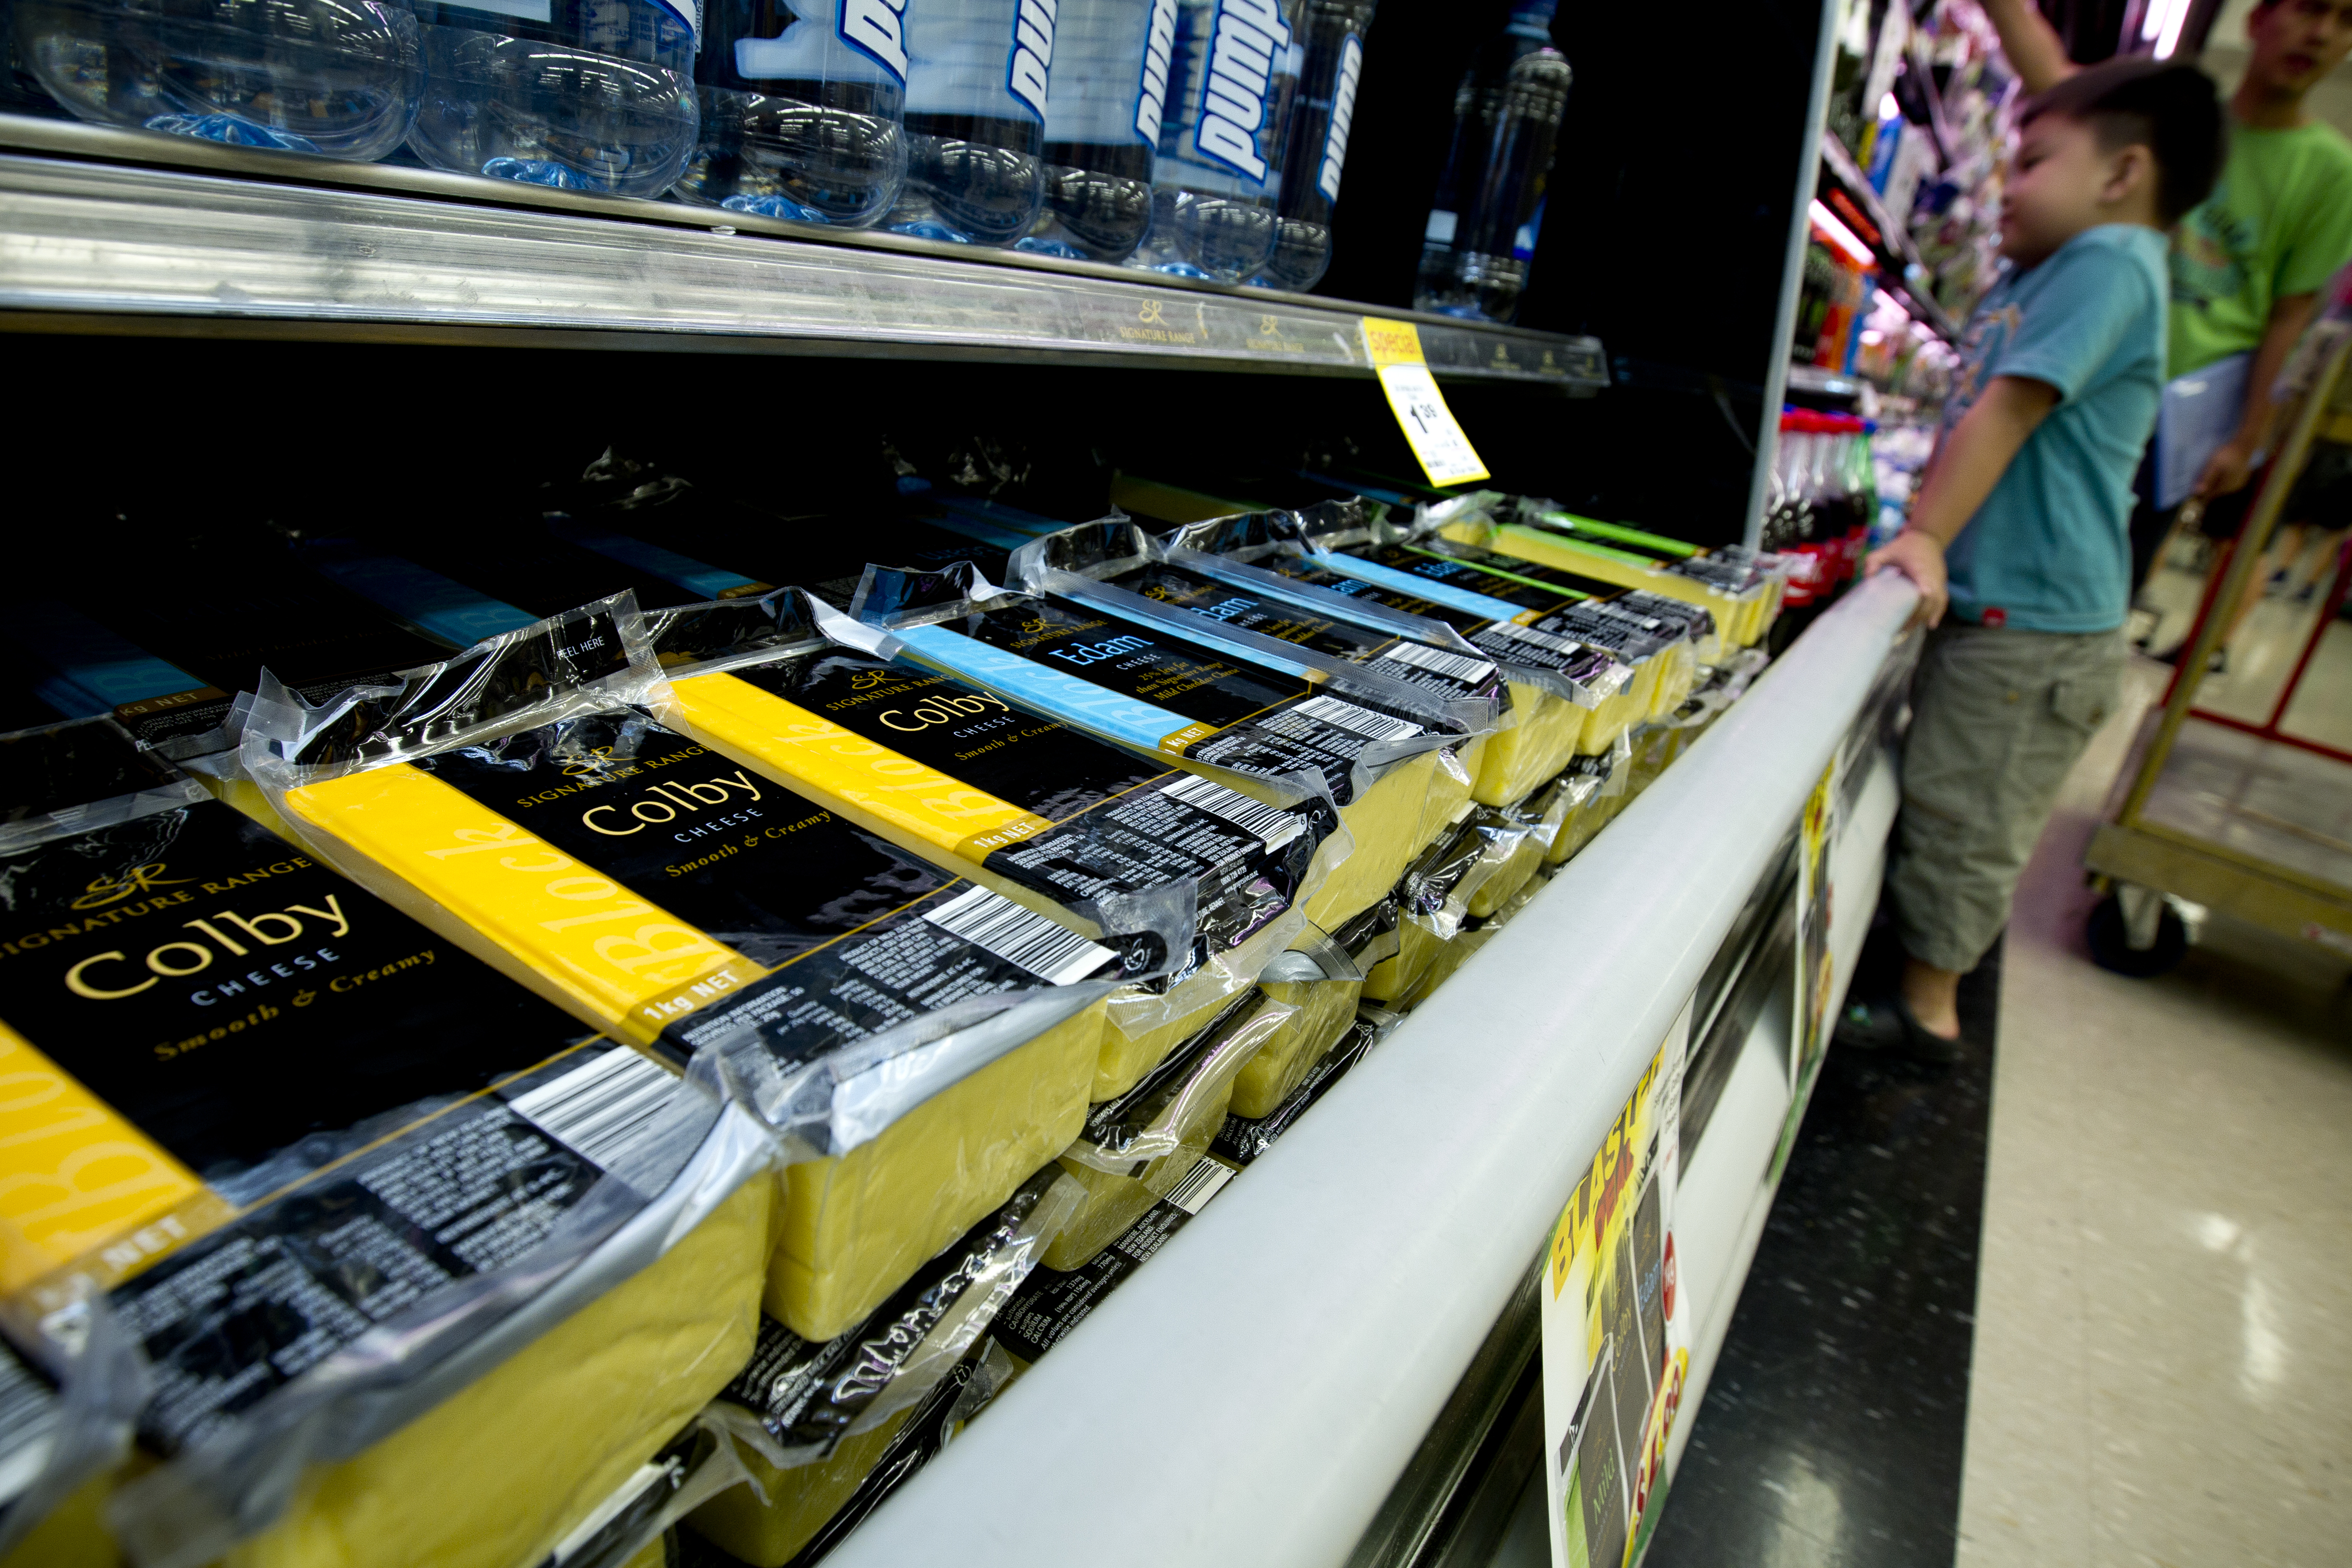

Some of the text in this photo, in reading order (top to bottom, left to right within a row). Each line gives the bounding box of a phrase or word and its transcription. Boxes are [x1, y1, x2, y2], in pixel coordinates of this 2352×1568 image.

[1170, 331, 1195, 344] RANGE
[1190, 597, 1260, 622] dam
[1238, 613, 1268, 627] HEESE
[581, 636, 605, 655] HERE
[1010, 619, 1108, 649] SIGNATURE RANGE
[1048, 635, 1154, 666] Edam
[1116, 653, 1162, 670] CHEESE
[1136, 661, 1224, 694] than Signature Range
[1173, 661, 1189, 673] for
[826, 673, 955, 710] SIGNATURE RANG
[1153, 668, 1240, 701] Mild Cheddar Cheese
[155, 693, 198, 706] NET
[879, 691, 1010, 732] Colby
[137, 702, 233, 734] UTRITION INFORMATION
[141, 719, 174, 737] ERVINGS
[953, 716, 1016, 738] CHEESE
[146, 723, 174, 740] ERVING
[955, 720, 1068, 761] Smooth & Creamy
[1180, 727, 1205, 739] NET
[517, 744, 714, 809] SIGNATURE RANGE
[772, 721, 1004, 821] Block
[582, 771, 762, 836] Colby
[1105, 807, 1127, 816] PRODUCT
[1112, 809, 1137, 820] PRODUCTS
[1129, 809, 1150, 818] QUALITY
[1155, 811, 1174, 819] RETURN
[1176, 808, 1194, 816] REFUND
[674, 808, 763, 843] CHEESE
[1002, 821, 1035, 839] NET
[1105, 829, 1125, 840] Quantity
[1163, 827, 1191, 841] REFRIGERATE
[1174, 830, 1209, 846] MANUFACTURED
[665, 810, 832, 878] Smooth & Creamy
[1035, 834, 1073, 850] INFORMATION
[1050, 838, 1079, 851] PACKAGE:
[1189, 837, 1210, 846] BRANDS
[1222, 851, 1245, 862] PRODUCT
[1237, 841, 1263, 854] ENQUIRIES:
[201, 856, 312, 895] RANGE
[1220, 865, 1247, 886] 0800 728 4739
[425, 822, 705, 976] Block
[64, 894, 350, 1000] Colby
[191, 947, 341, 1007] CHEESE
[154, 948, 437, 1062] Smooth & Creamy
[643, 996, 695, 1020] 1kg
[691, 969, 739, 998] NET
[1217, 1116, 1231, 1139] SODIUM
[1224, 1117, 1239, 1142] CALCIUM
[1237, 1120, 1248, 1137] values
[1594, 1138, 1634, 1252] DEAL
[1117, 1228, 1141, 1251] MANGERE,
[1137, 1209, 1161, 1232] AUCKLAND,
[1124, 1242, 1137, 1255] NEW
[1134, 1225, 1156, 1247] ZEALAND.
[1131, 1212, 1179, 1259] FOR PRODUCT ENQUIRIES:
[1097, 1254, 1115, 1270] 770mg
[1138, 1250, 1151, 1263] NEW
[1639, 1258, 1661, 1314] Edam
[1005, 1296, 1027, 1321] saturated
[1008, 1290, 1044, 1330] CARBOHYDRATE
[1023, 1274, 1085, 1340] SODIUM 137mg
[1030, 1278, 1091, 1344] CALCIUM 154mg
[1040, 1337, 1051, 1351] All
[1047, 1320, 1064, 1339] values
[1062, 1313, 1071, 1323] are
[1069, 1291, 1093, 1316] considered
[1090, 1273, 1110, 1294] averages
[1108, 1261, 1123, 1277] unless
[1069, 1305, 1092, 1327] indicated.
[1019, 1311, 1034, 1331] sugars
[1593, 1448, 1616, 1526] Mild
